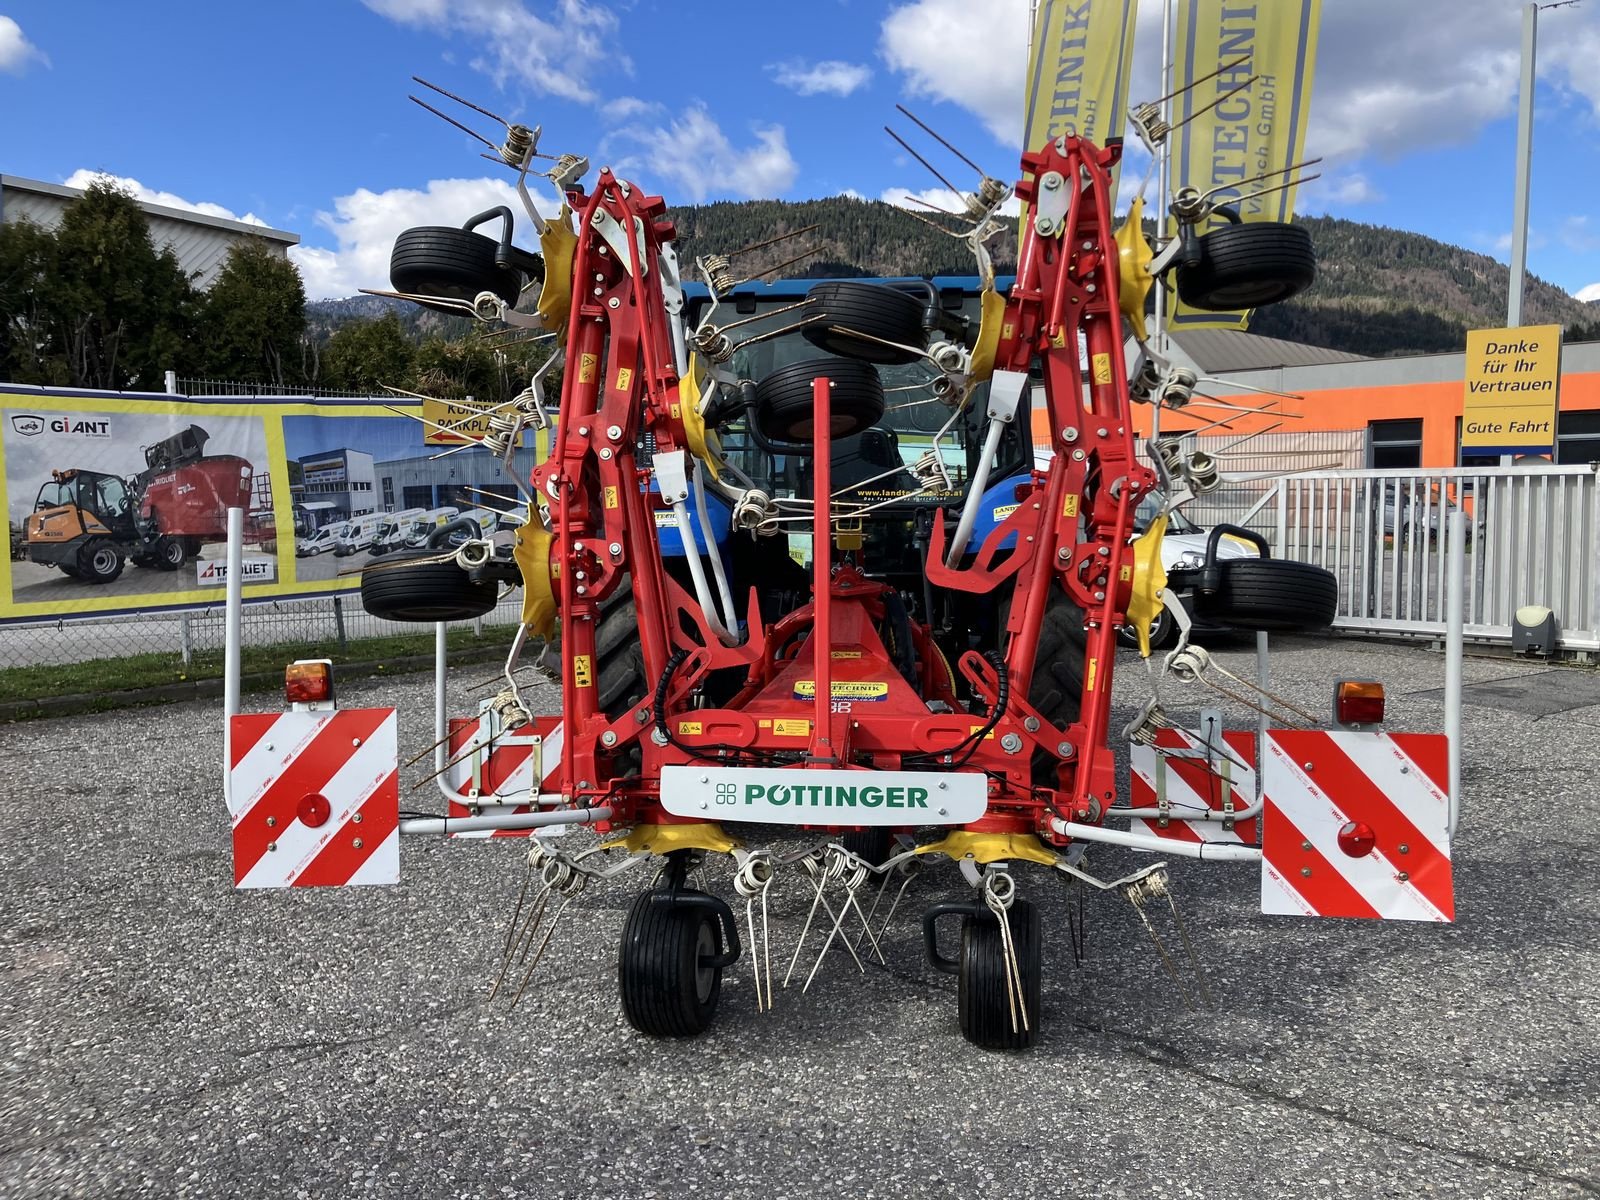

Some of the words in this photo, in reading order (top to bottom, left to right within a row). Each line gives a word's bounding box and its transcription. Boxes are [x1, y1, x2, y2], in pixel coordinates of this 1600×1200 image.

[1257, 75, 1276, 135] GmbH
[1485, 340, 1539, 355] Danke
[1483, 360, 1508, 374] für
[1514, 359, 1537, 373] Ihr
[1469, 380, 1553, 393] Vertrauen
[1466, 422, 1502, 433] Gute
[1509, 420, 1550, 433] Fahrt
[744, 784, 928, 808] PÖTTINGER
